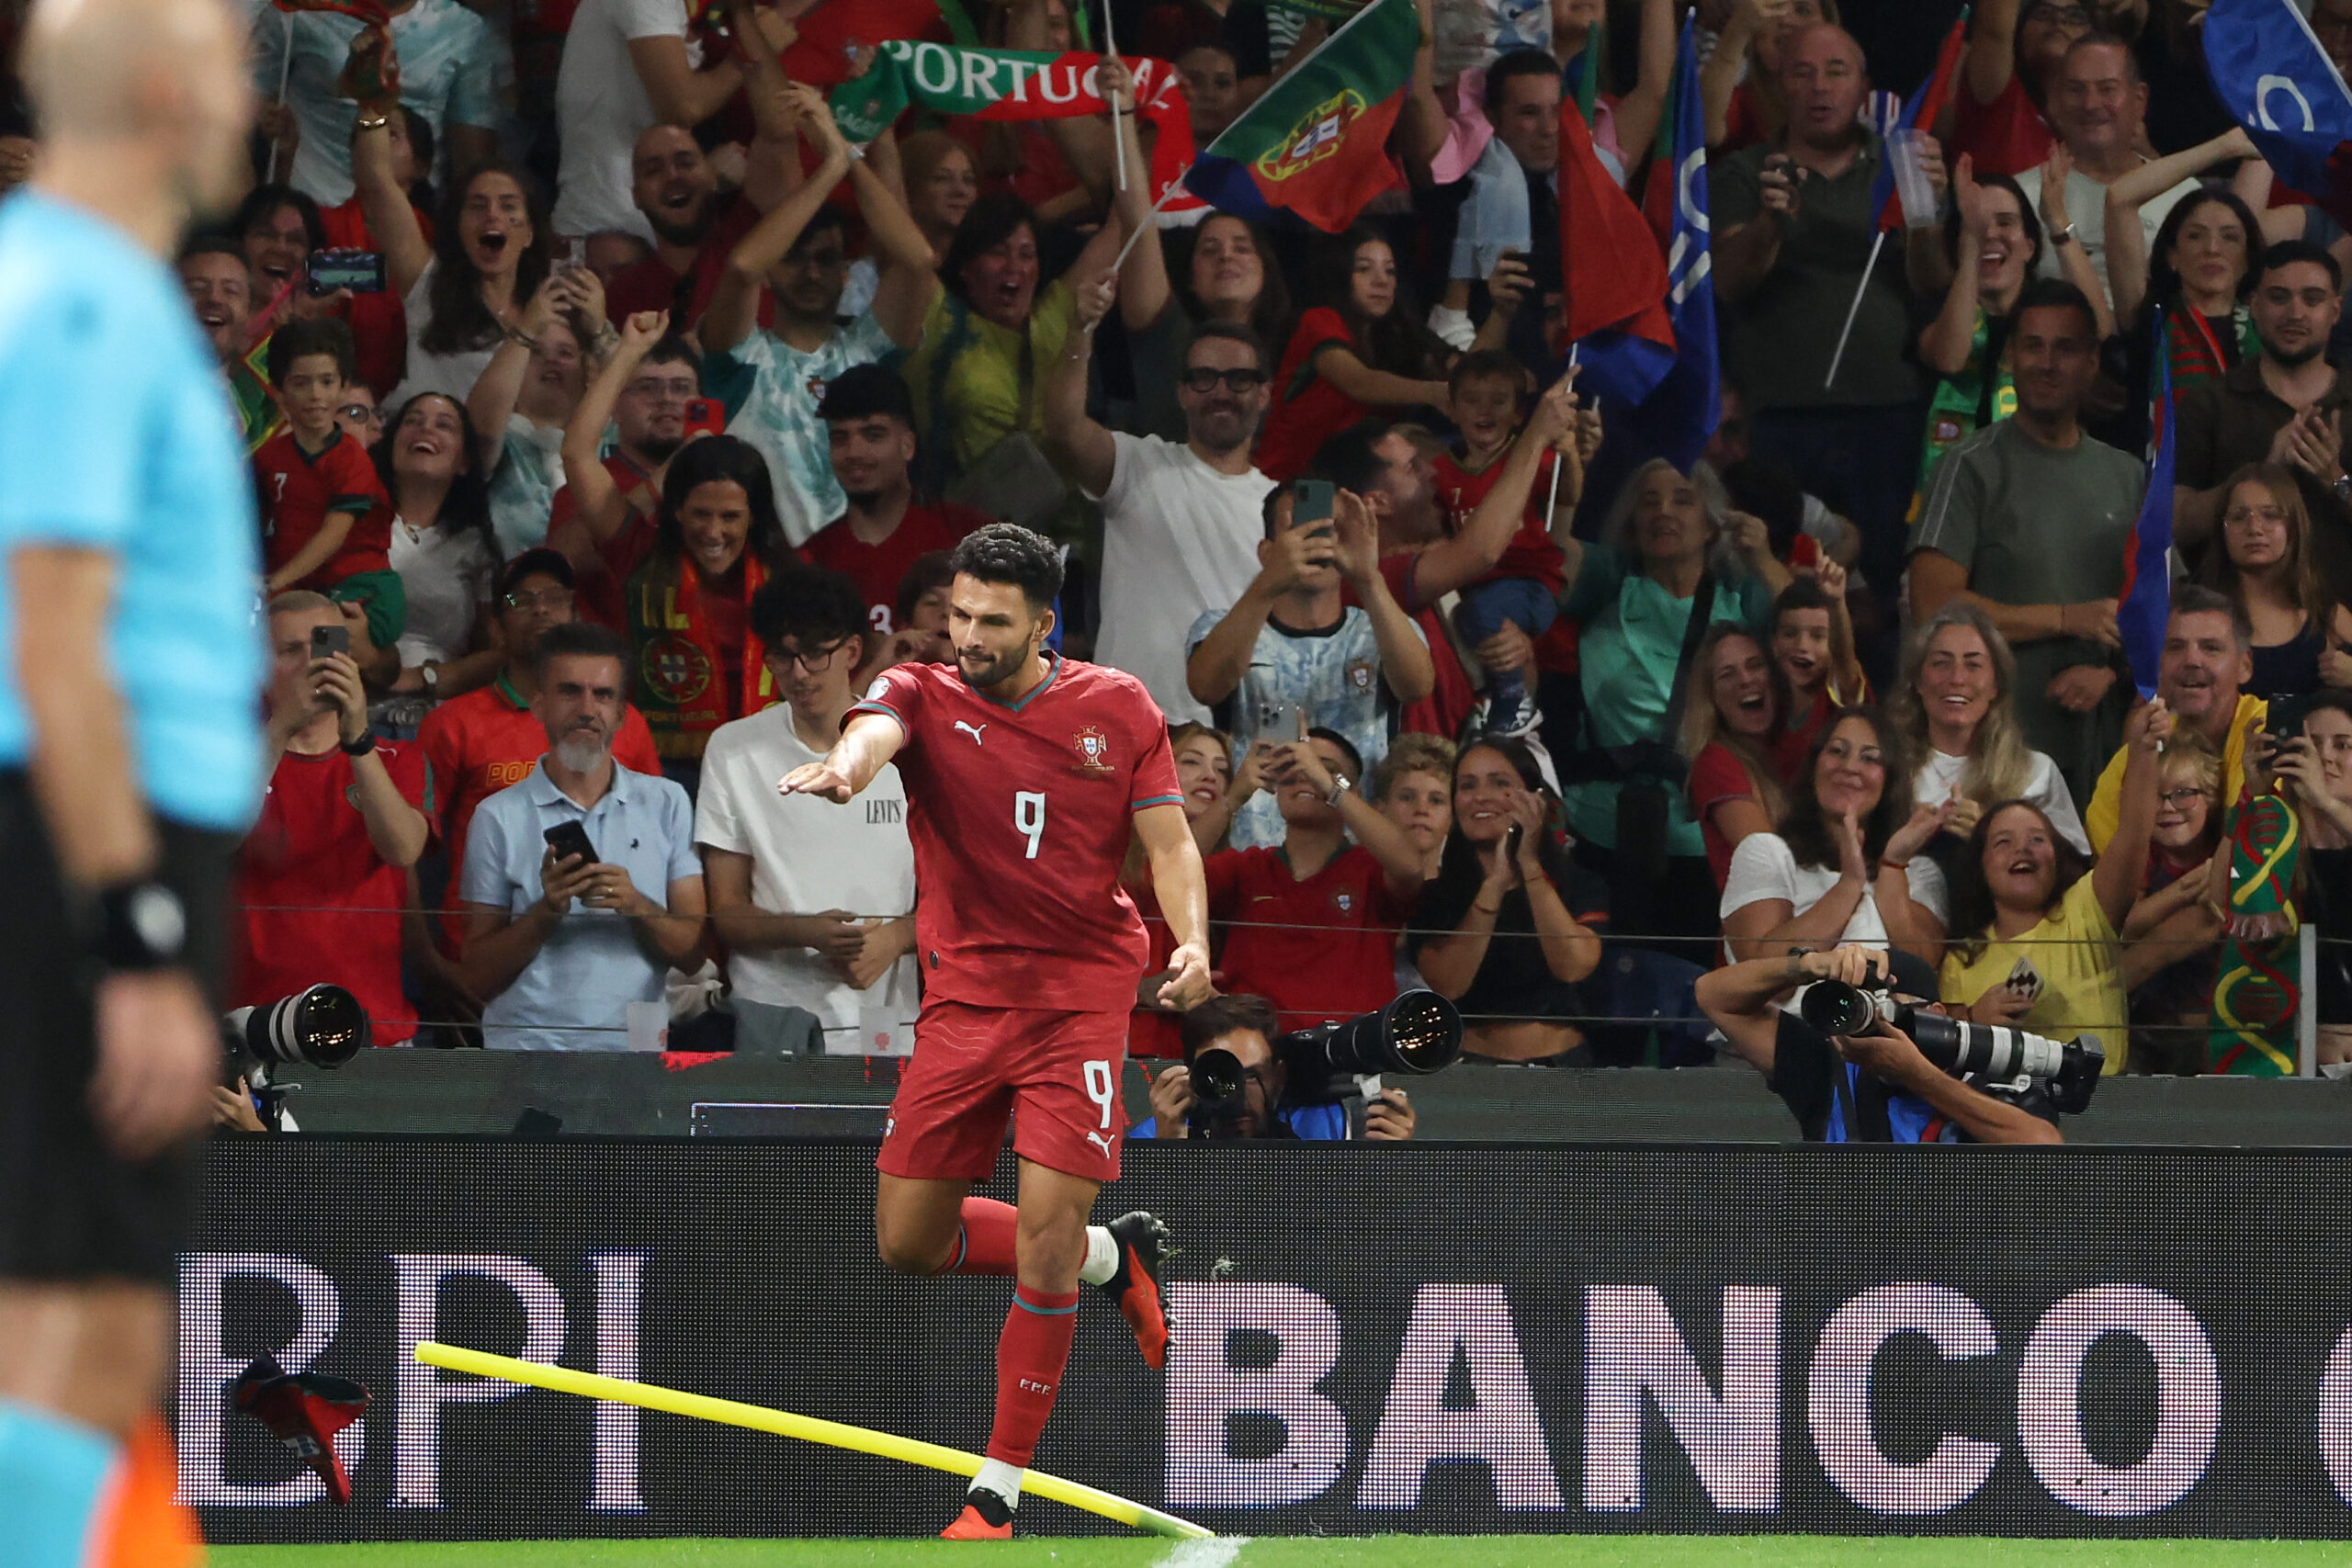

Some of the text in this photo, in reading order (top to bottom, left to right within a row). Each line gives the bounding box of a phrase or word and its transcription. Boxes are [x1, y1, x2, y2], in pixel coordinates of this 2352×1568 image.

[274, 472, 288, 502] 7
[1015, 791, 1046, 859] 9
[1083, 1060, 1114, 1129] 9
[173, 1247, 656, 1515] BPI
[1165, 1281, 2222, 1515] BANCO
